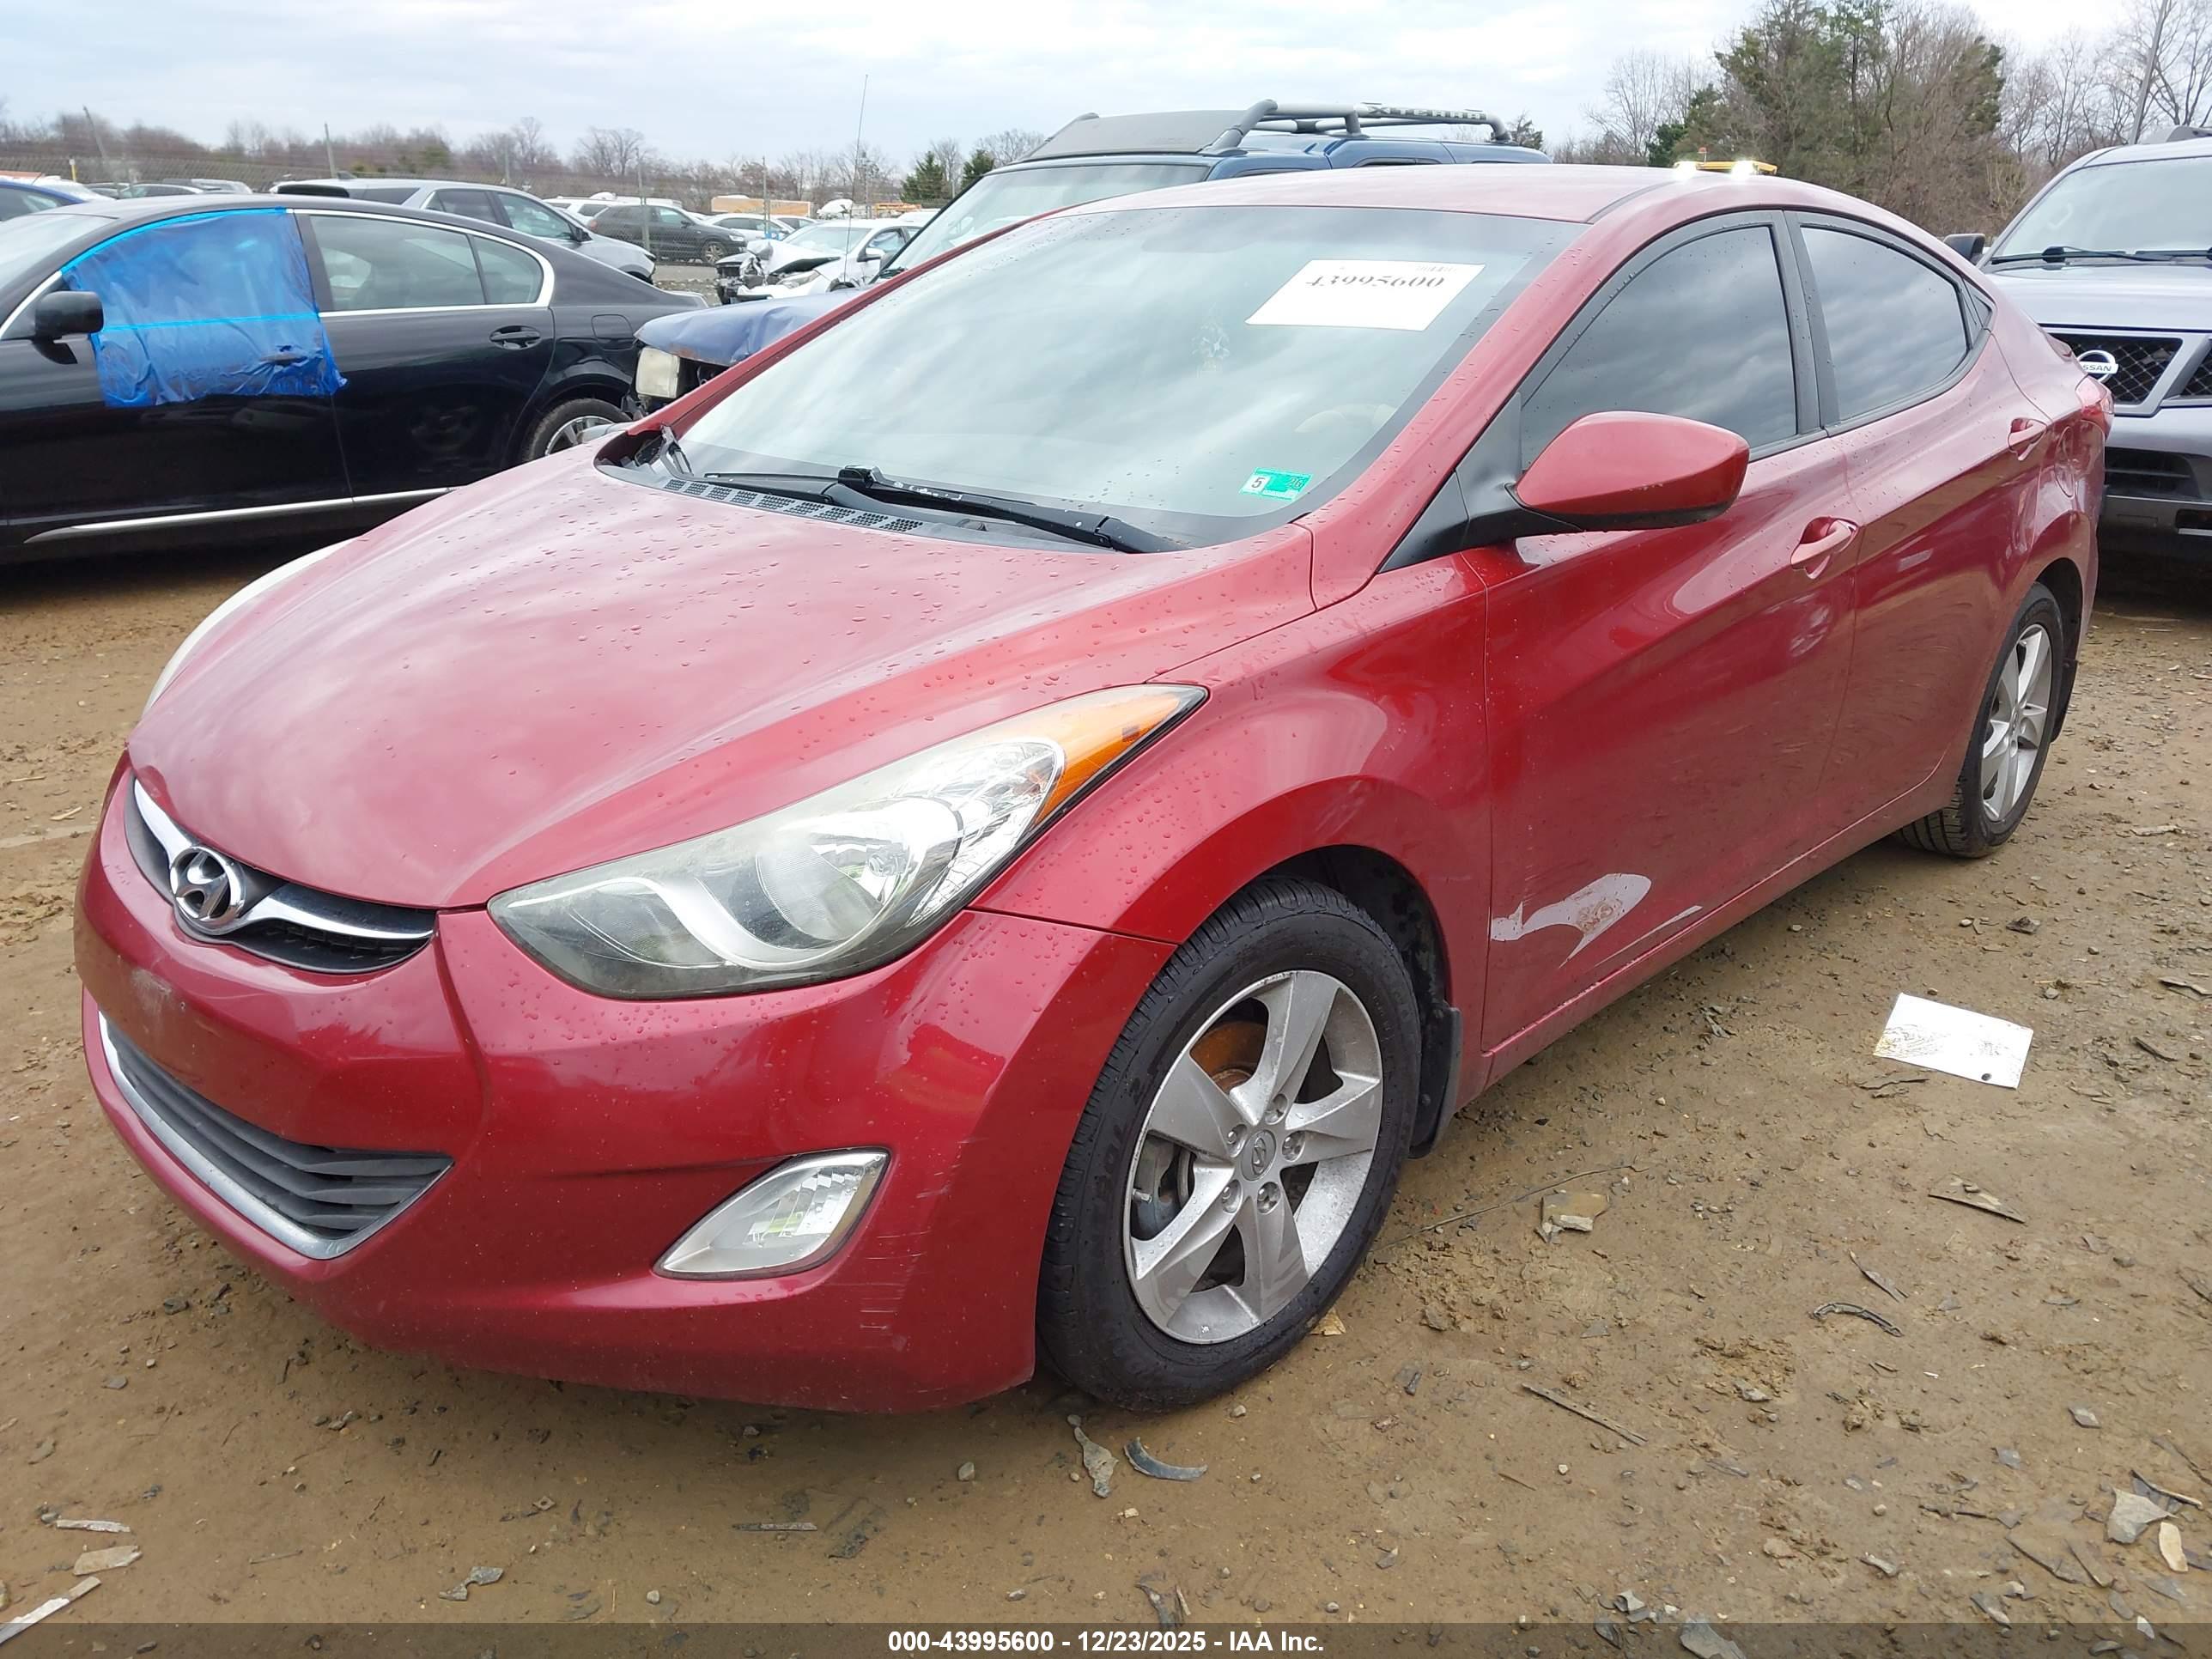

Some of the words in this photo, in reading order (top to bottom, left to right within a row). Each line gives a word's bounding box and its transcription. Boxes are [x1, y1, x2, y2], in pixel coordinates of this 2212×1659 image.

[1368, 105, 1486, 120] XTERRA
[1305, 275, 1445, 287] 43995600
[1251, 477, 1266, 489] 5
